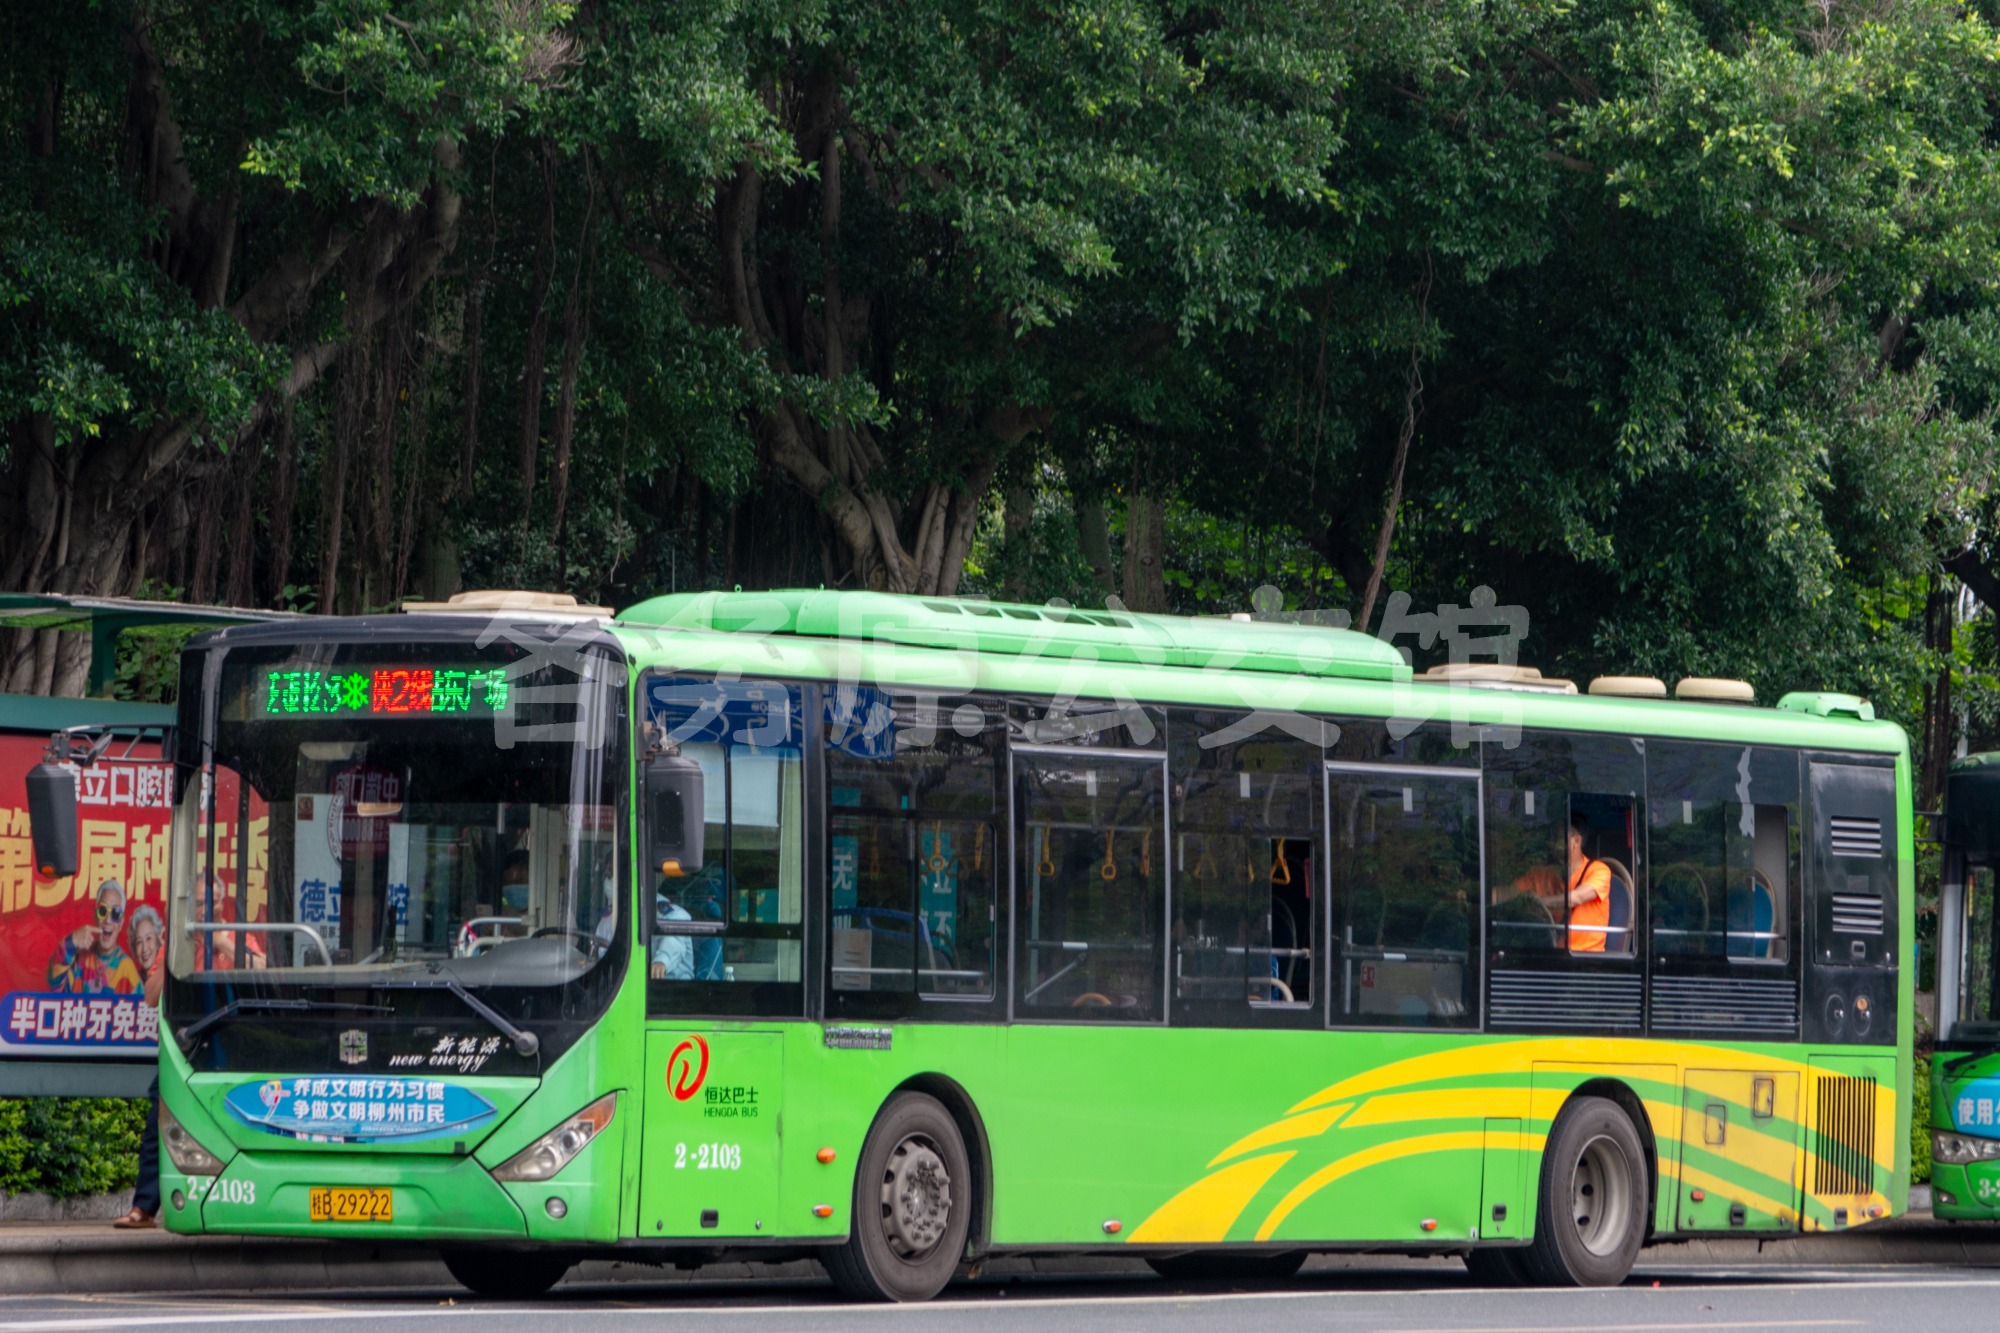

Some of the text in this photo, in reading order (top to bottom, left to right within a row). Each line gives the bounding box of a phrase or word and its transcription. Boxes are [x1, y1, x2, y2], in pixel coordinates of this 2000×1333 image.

[58, 762, 217, 810] 立口腔
[299, 878, 409, 926] 德立腔
[11, 998, 159, 1041] 半口种牙免费
[432, 1036, 500, 1054] 新能源
[389, 1054, 490, 1073] new energy
[293, 1079, 445, 1101] 养成文明行为习惯
[704, 1087, 758, 1104] 恒达巴士
[293, 1101, 445, 1123] 争做文明柳州市民
[704, 1107, 758, 1118] HENGDA BUS
[1958, 1098, 2000, 1126] 使用
